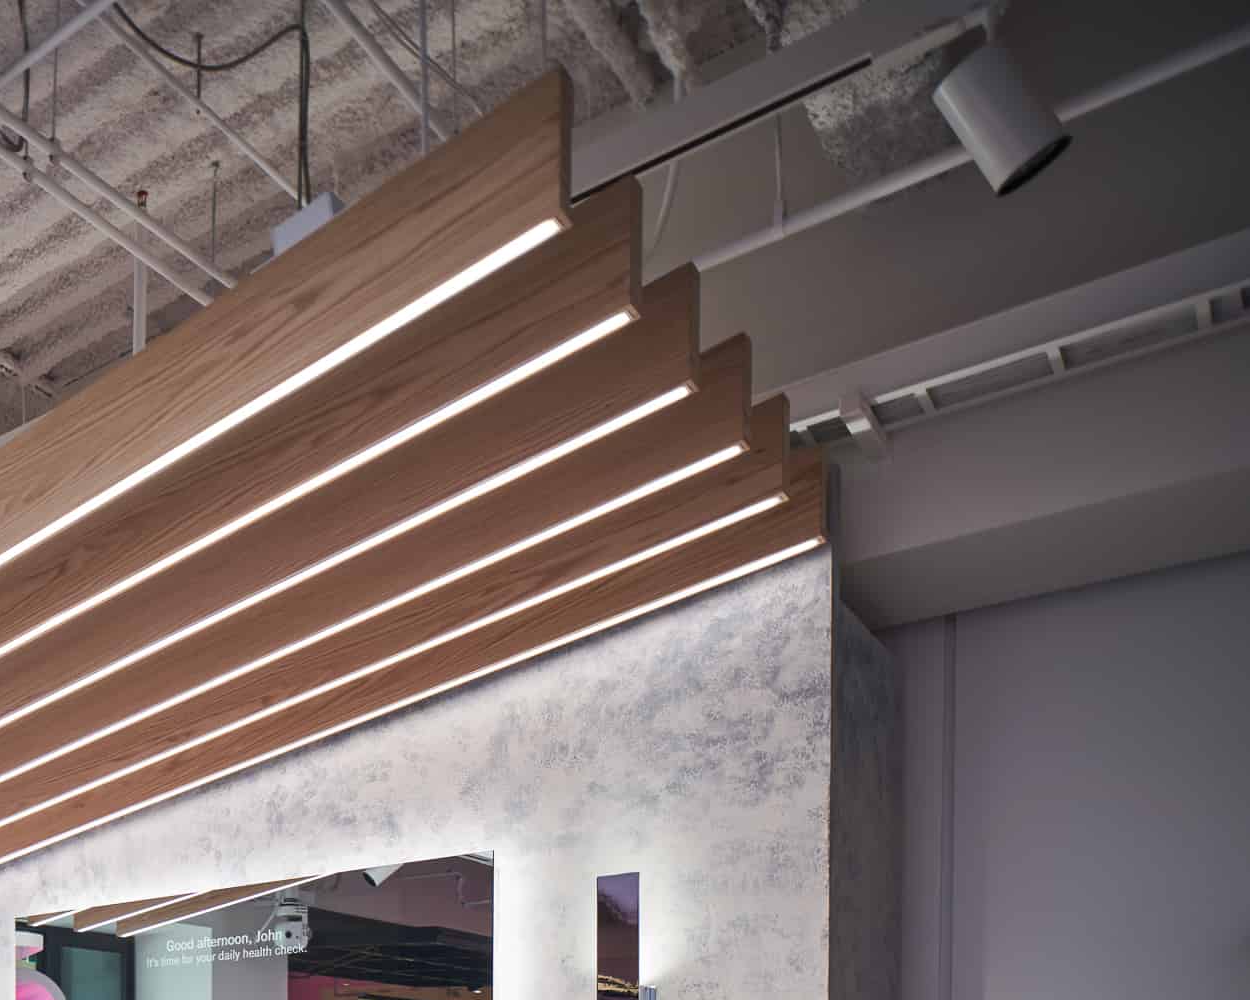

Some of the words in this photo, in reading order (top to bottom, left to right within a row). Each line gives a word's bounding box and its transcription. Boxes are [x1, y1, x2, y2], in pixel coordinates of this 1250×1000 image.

[166, 937, 194, 952] Good
[197, 934, 252, 949] afternoon,
[255, 929, 282, 943] John
[196, 952, 216, 967] your
[218, 949, 240, 962] daily
[242, 945, 272, 959] health
[274, 943, 308, 956] check.
